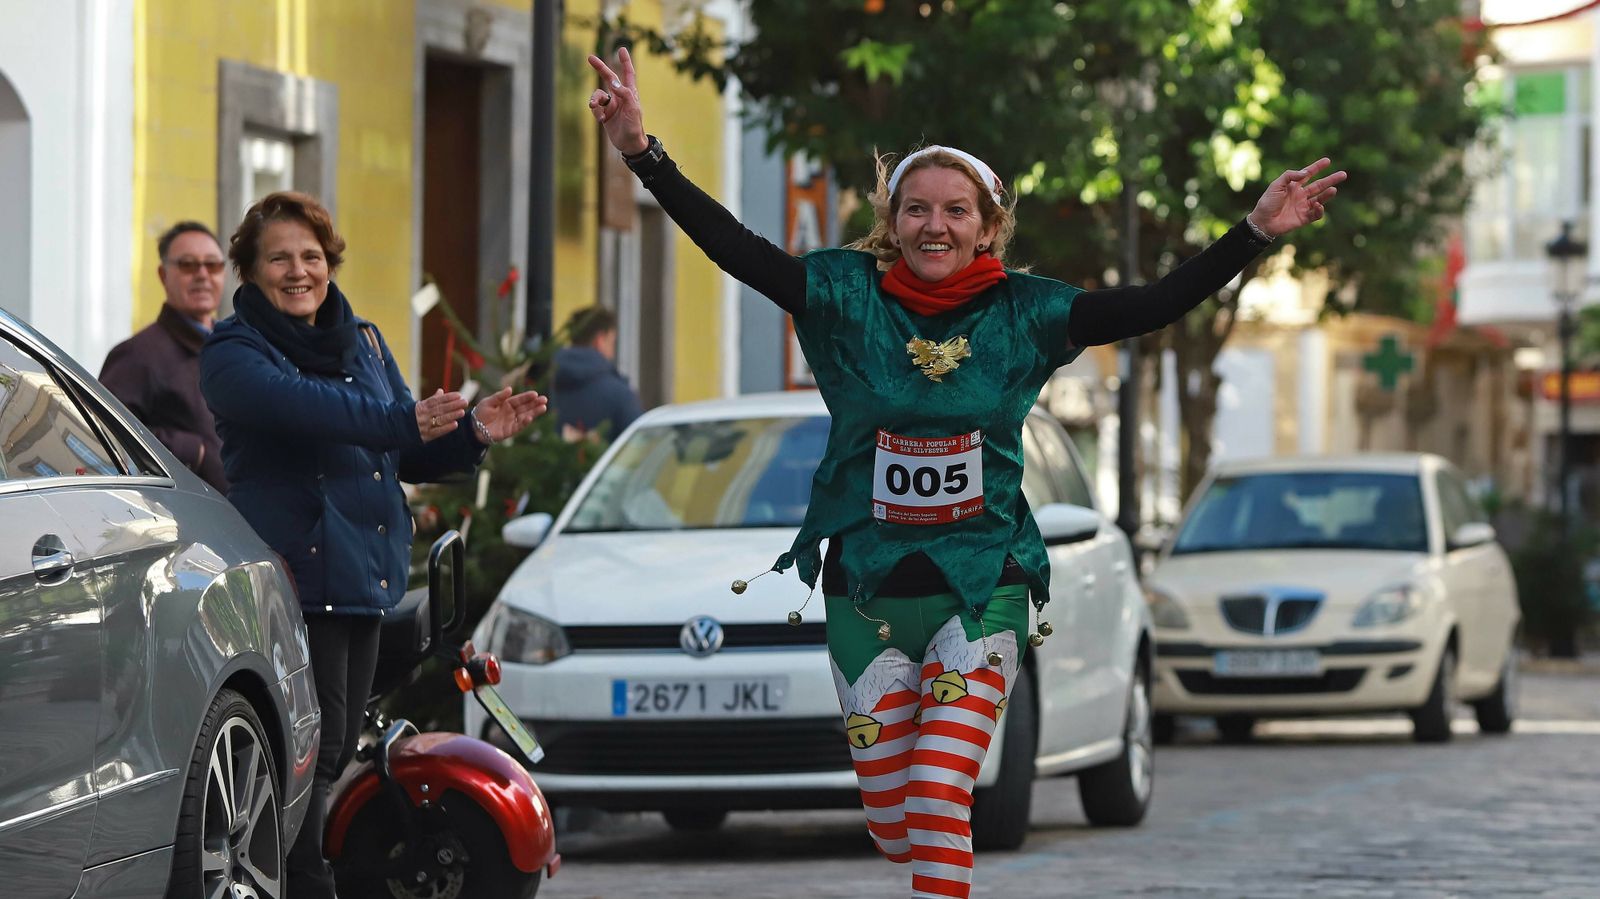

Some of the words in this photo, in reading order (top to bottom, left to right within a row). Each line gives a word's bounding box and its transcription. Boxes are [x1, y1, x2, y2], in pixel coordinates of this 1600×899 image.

[893, 438, 924, 447] CARRERA
[926, 440, 957, 448] POPULAR
[885, 462, 969, 497] 005
[961, 504, 984, 515] TARIFA
[633, 683, 707, 713] 2671
[723, 681, 780, 712] JKL
